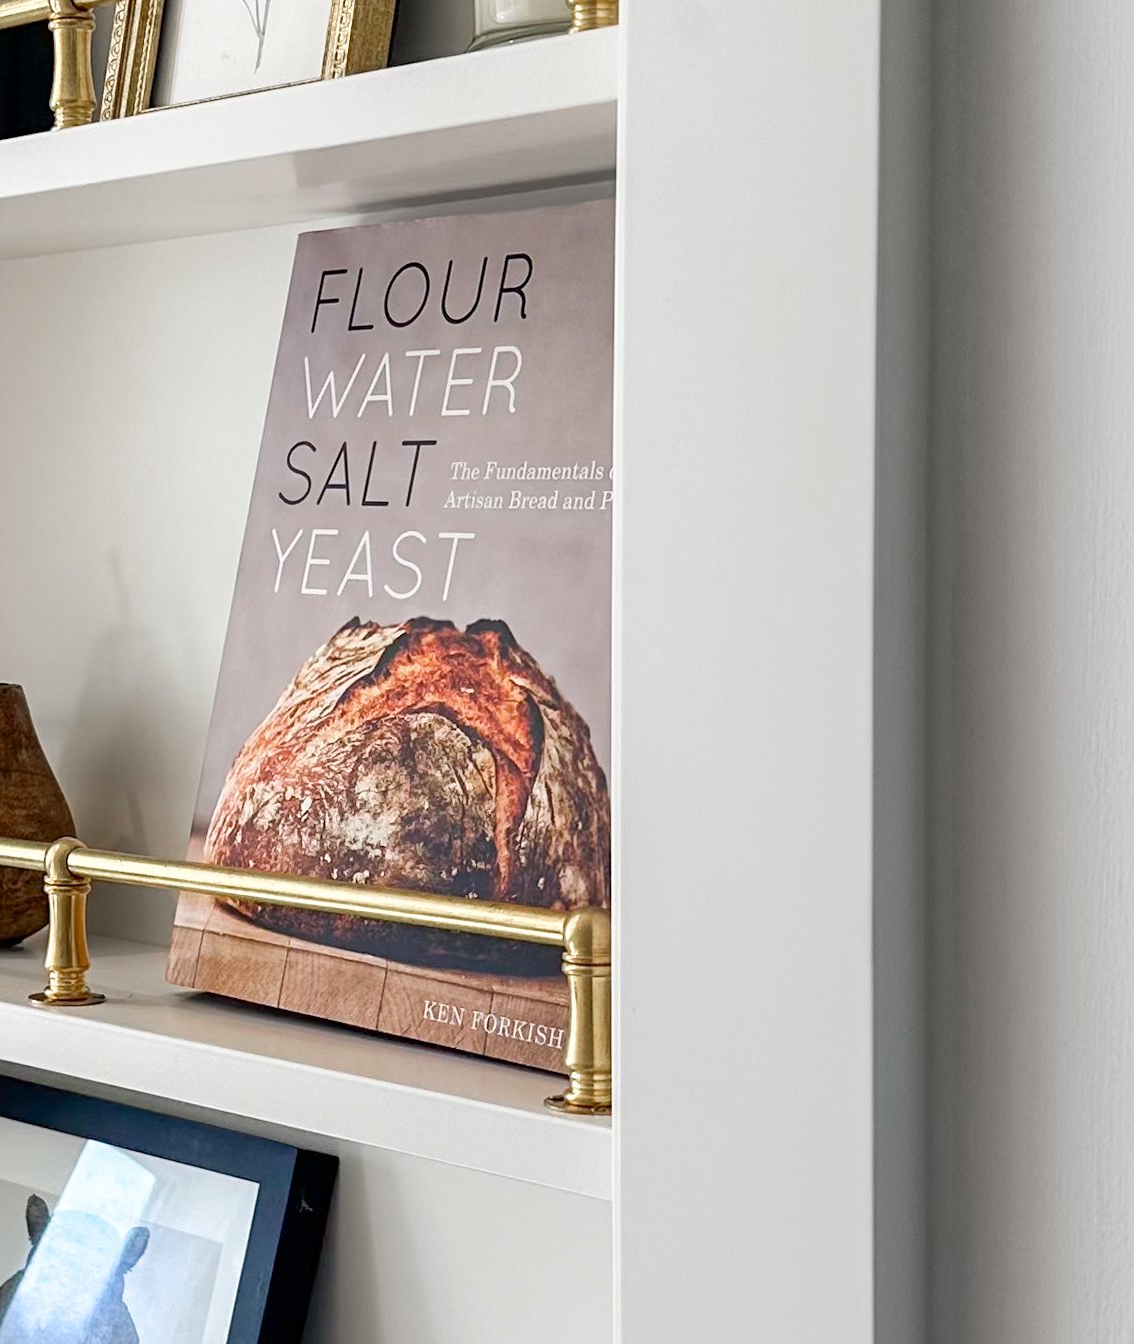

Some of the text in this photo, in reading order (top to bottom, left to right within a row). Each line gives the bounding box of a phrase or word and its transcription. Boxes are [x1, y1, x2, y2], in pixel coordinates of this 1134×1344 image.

[311, 253, 533, 333] FLOUR
[304, 345, 523, 419] WATER
[278, 440, 437, 508] SALT
[444, 490, 503, 509] Artisan
[508, 490, 559, 510] Bread
[563, 491, 596, 510] and
[450, 461, 480, 480] The
[483, 460, 604, 480] Fundamentals
[271, 528, 476, 603] YEAST
[423, 1000, 565, 1050] KEN FORKISH
